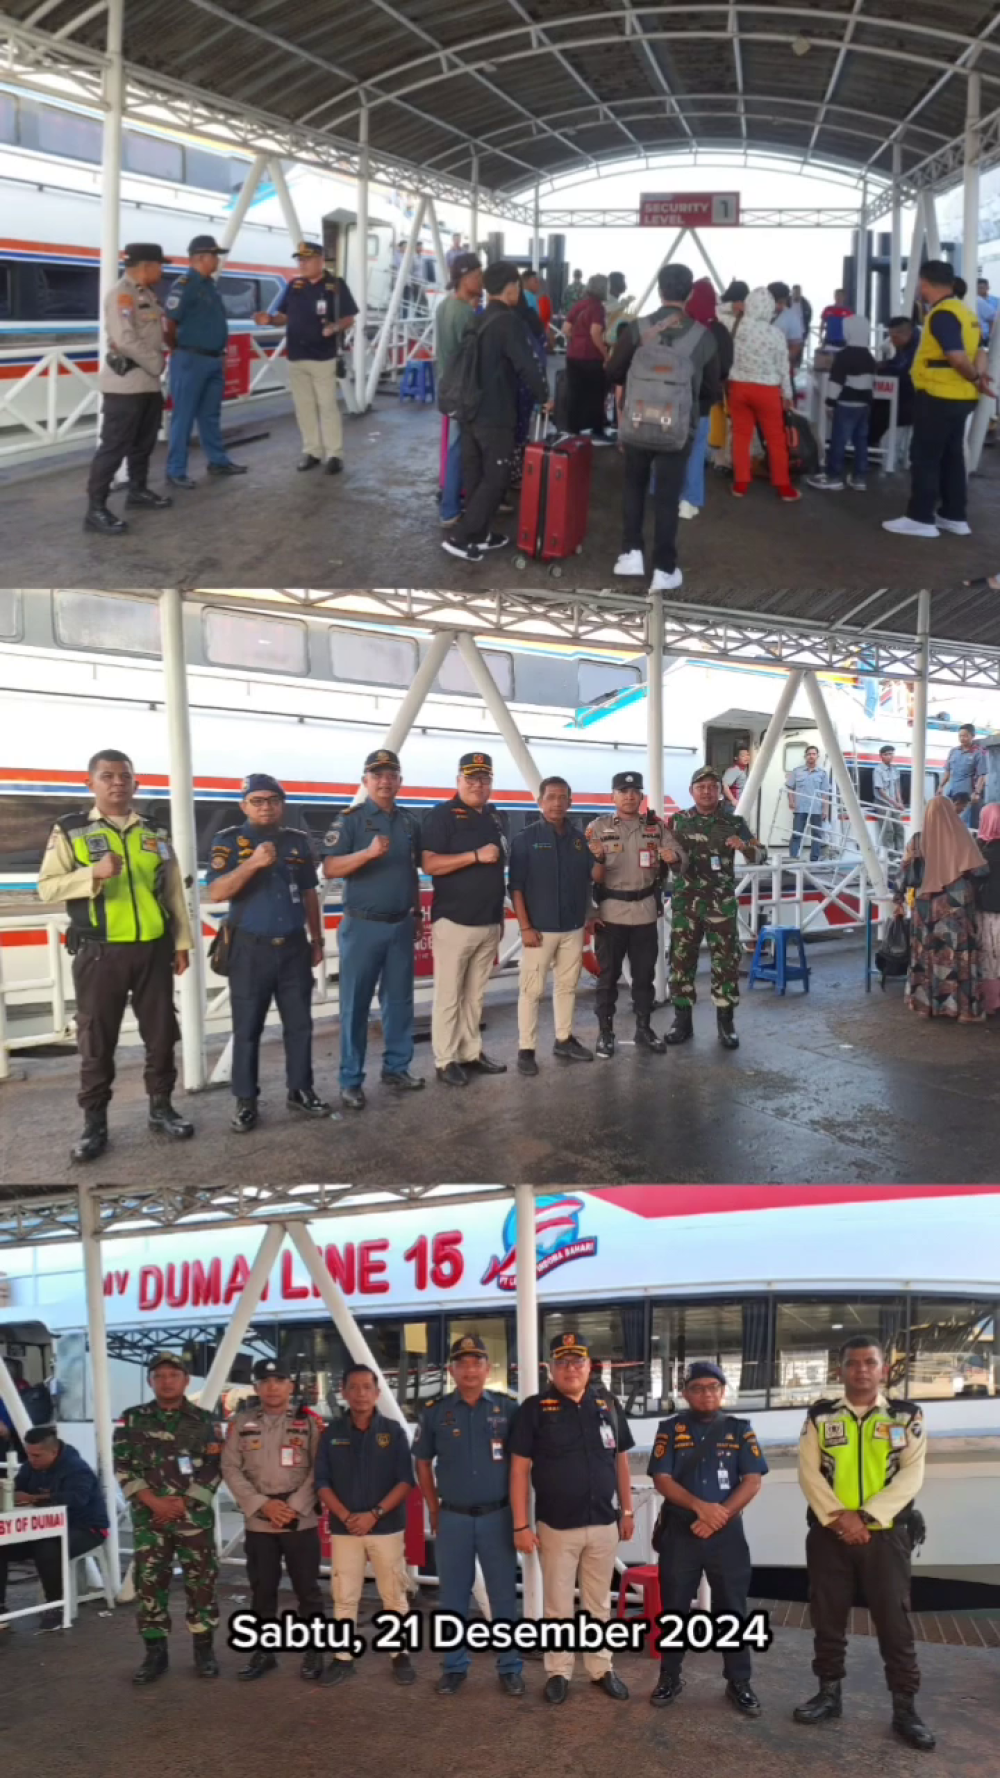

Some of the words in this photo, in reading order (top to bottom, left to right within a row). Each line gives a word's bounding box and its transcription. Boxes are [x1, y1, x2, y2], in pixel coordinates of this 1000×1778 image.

[644, 203, 709, 214] SECURITY
[719, 199, 729, 219] 1
[643, 214, 685, 225] LEVEL
[564, 1242, 594, 1256] BAHARI
[138, 1254, 269, 1311] DUMA
[403, 1229, 465, 1290] 15
[15, 1517, 29, 1533] OF
[31, 1512, 65, 1530] DUMAI
